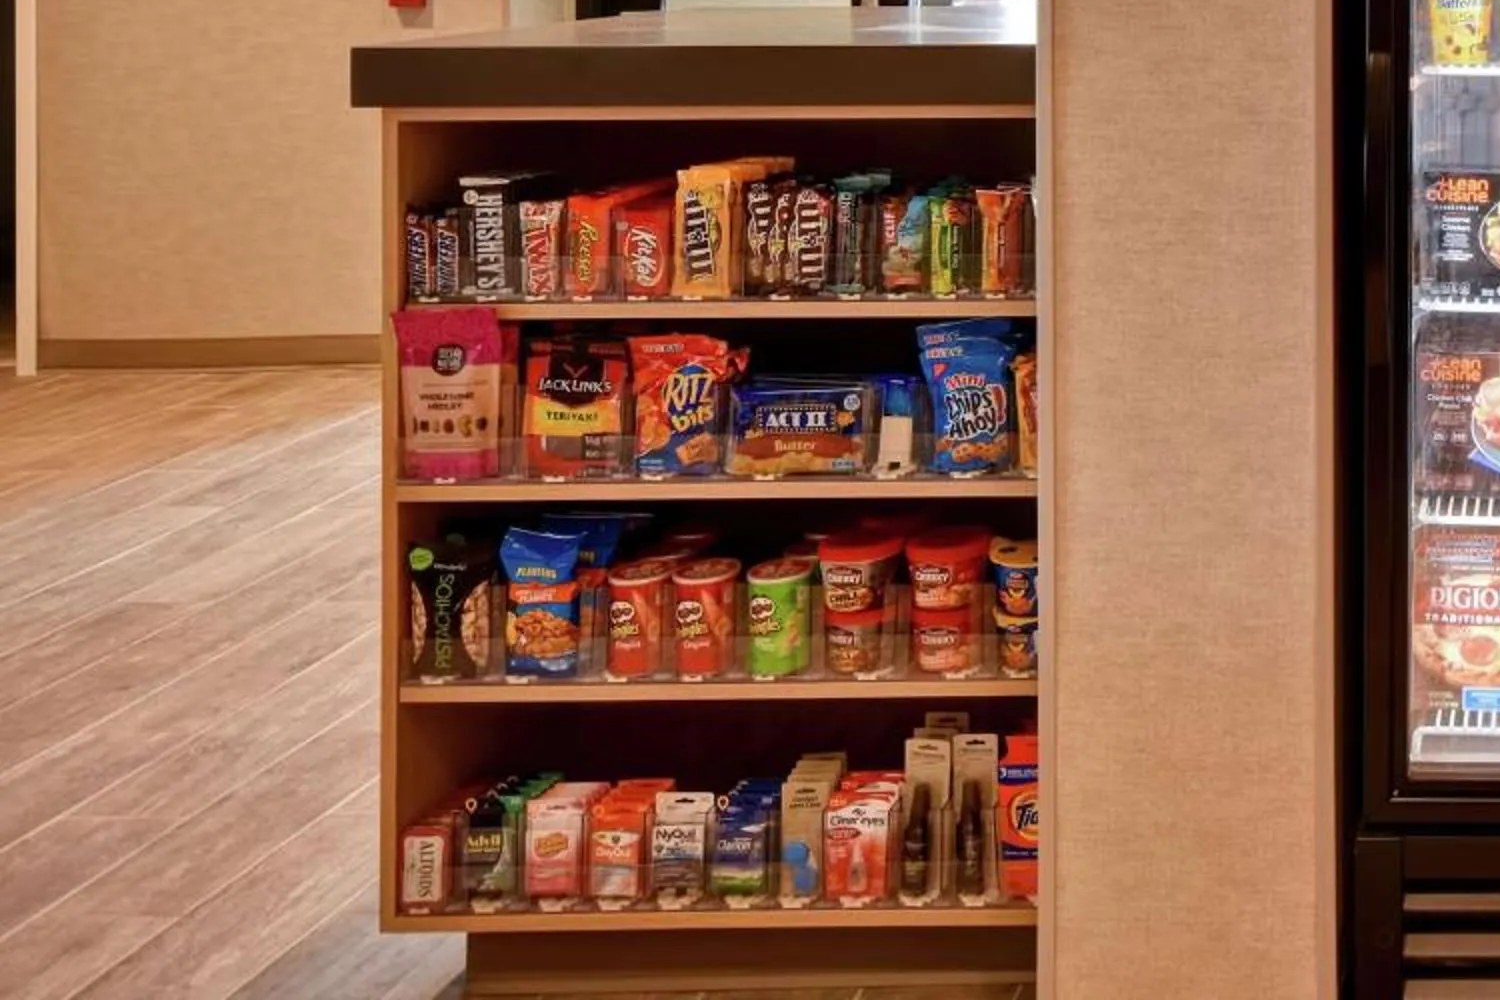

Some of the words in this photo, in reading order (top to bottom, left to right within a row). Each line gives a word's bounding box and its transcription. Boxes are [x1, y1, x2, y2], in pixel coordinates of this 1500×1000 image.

[475, 193, 504, 293] HERSHEY'S
[525, 219, 553, 296] TWIX
[538, 377, 571, 392] JACK
[665, 373, 713, 411] RITZ
[546, 410, 599, 422] TERIYAKI
[766, 411, 800, 427] ACT
[806, 411, 827, 427] II
[774, 440, 816, 452] Butter
[434, 574, 455, 669] PISTACHIOS
[1015, 802, 1038, 830] Ti
[417, 840, 432, 897] ALTOIDS
